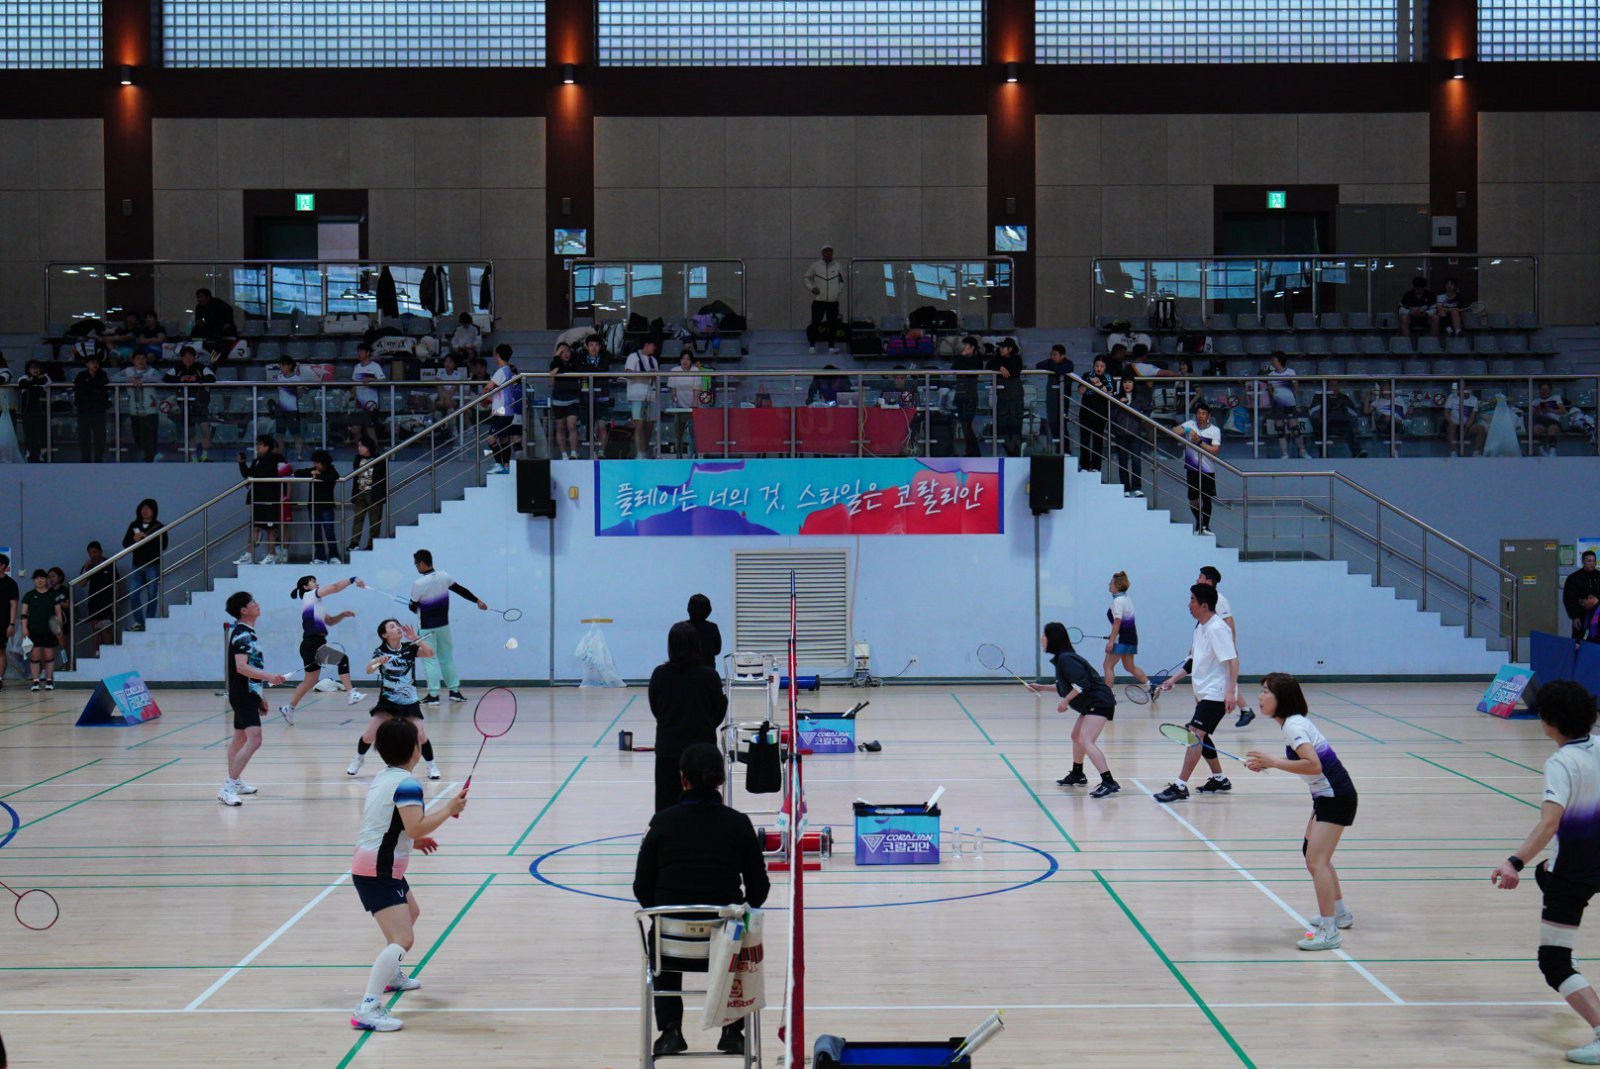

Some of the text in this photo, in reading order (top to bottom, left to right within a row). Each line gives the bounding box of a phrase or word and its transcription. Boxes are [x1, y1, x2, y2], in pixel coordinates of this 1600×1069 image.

[614, 482, 698, 517] 플레이는
[708, 487, 749, 507] 너의
[797, 479, 883, 516] 스타일은
[894, 478, 984, 516] 코랄리안
[886, 833, 934, 841] CORALIAN
[882, 841, 931, 853] 코랄리안
